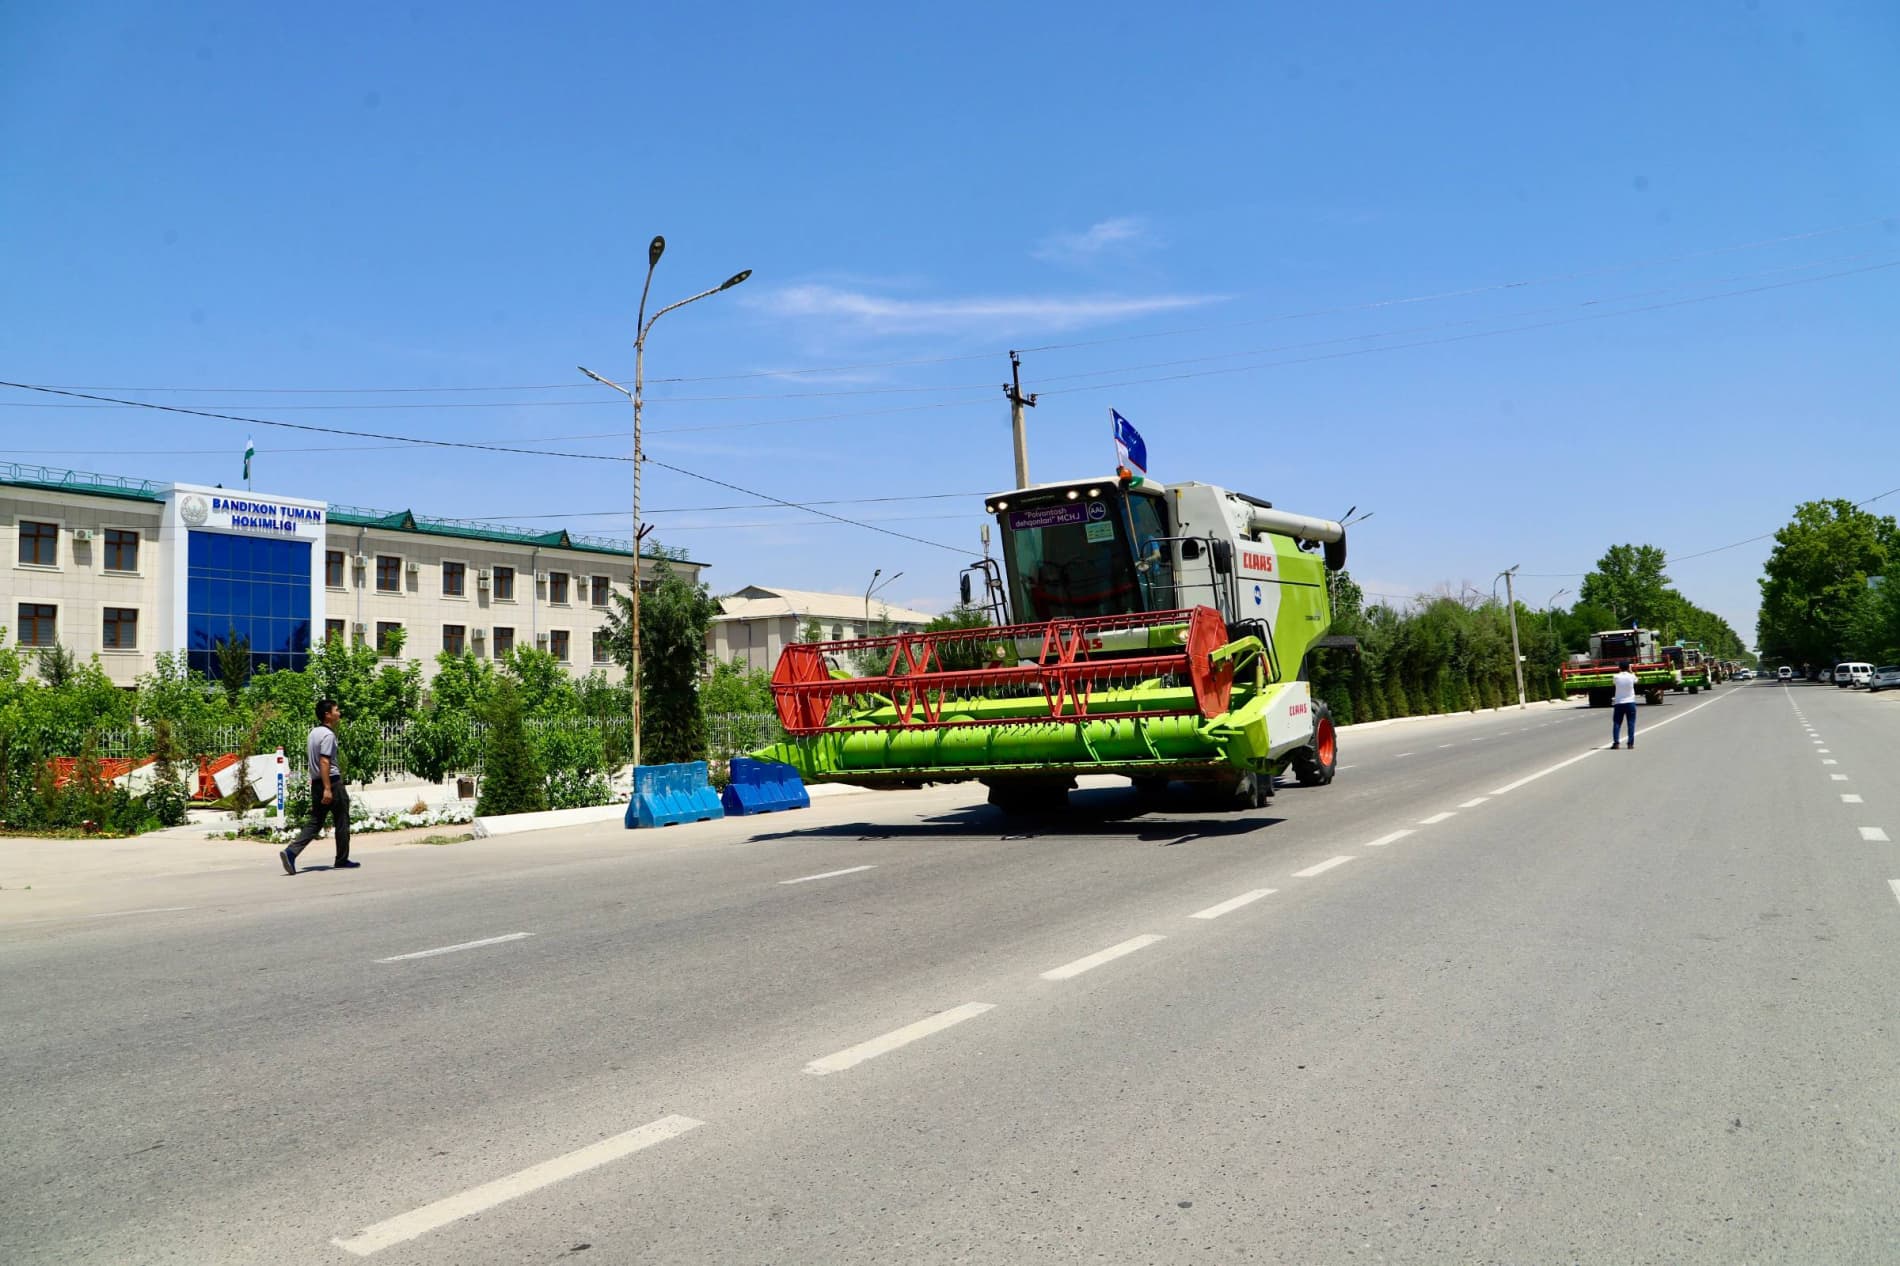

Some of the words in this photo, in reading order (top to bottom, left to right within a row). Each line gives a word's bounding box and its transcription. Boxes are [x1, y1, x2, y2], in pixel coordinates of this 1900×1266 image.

[212, 498, 276, 515] BANDIXON
[280, 506, 321, 521] TUMAN
[1057, 511, 1080, 521] MCHJ
[231, 515, 296, 532] HOKIMLIGI
[1243, 552, 1272, 572] CLAAS
[1289, 704, 1307, 716] CLAAS
